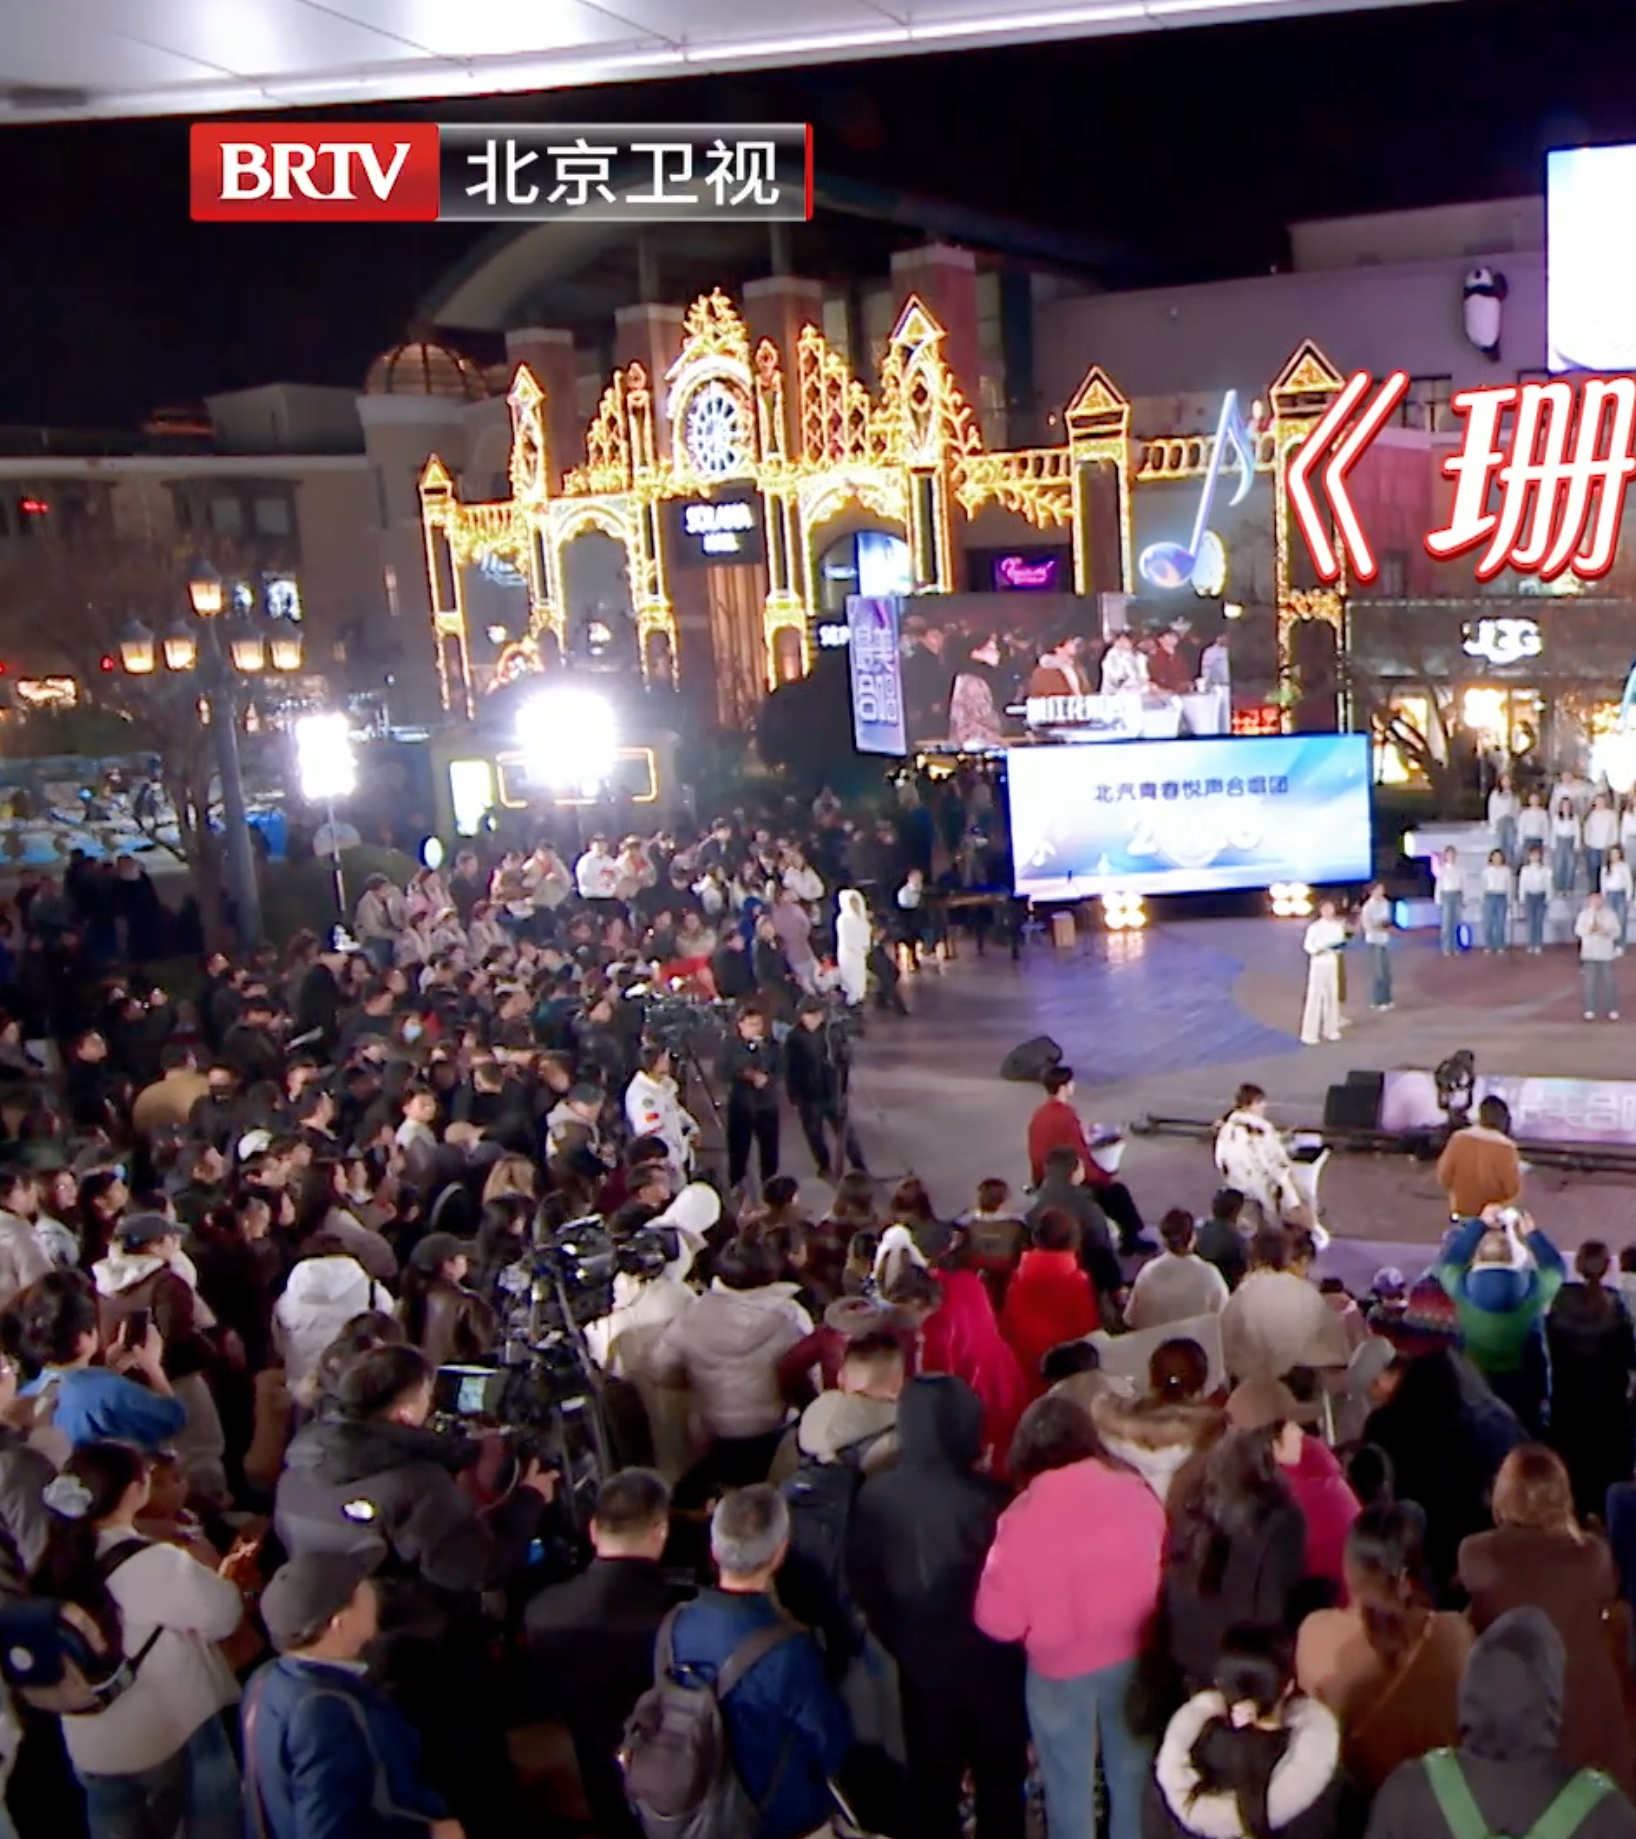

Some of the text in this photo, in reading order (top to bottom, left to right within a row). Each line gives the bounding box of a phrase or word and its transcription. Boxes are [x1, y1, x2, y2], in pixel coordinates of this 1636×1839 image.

[1094, 775, 1289, 803] 北汽青春悦声合唱团
